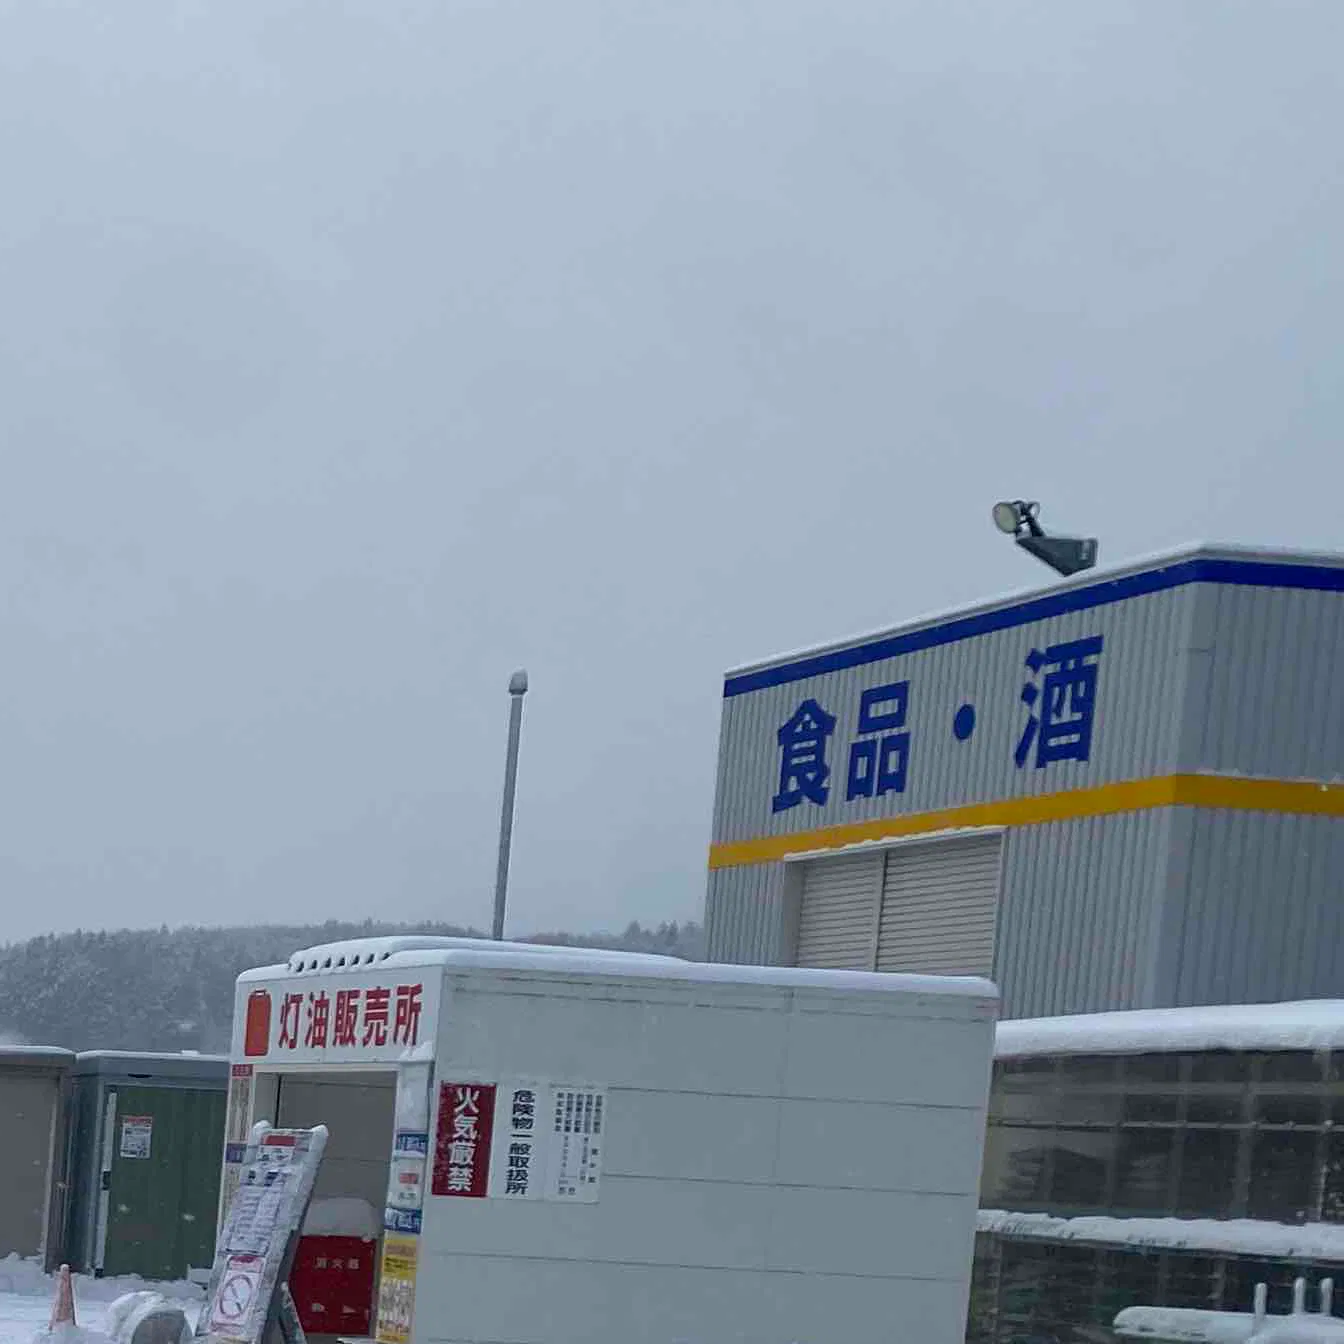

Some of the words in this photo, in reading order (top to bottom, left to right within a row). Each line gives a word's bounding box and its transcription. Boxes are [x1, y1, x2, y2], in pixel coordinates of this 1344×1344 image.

[772, 635, 1104, 814] 食品・酒
[278, 984, 423, 1049] 灯油販売所
[505, 1089, 536, 1195] 危険物一般取扱所
